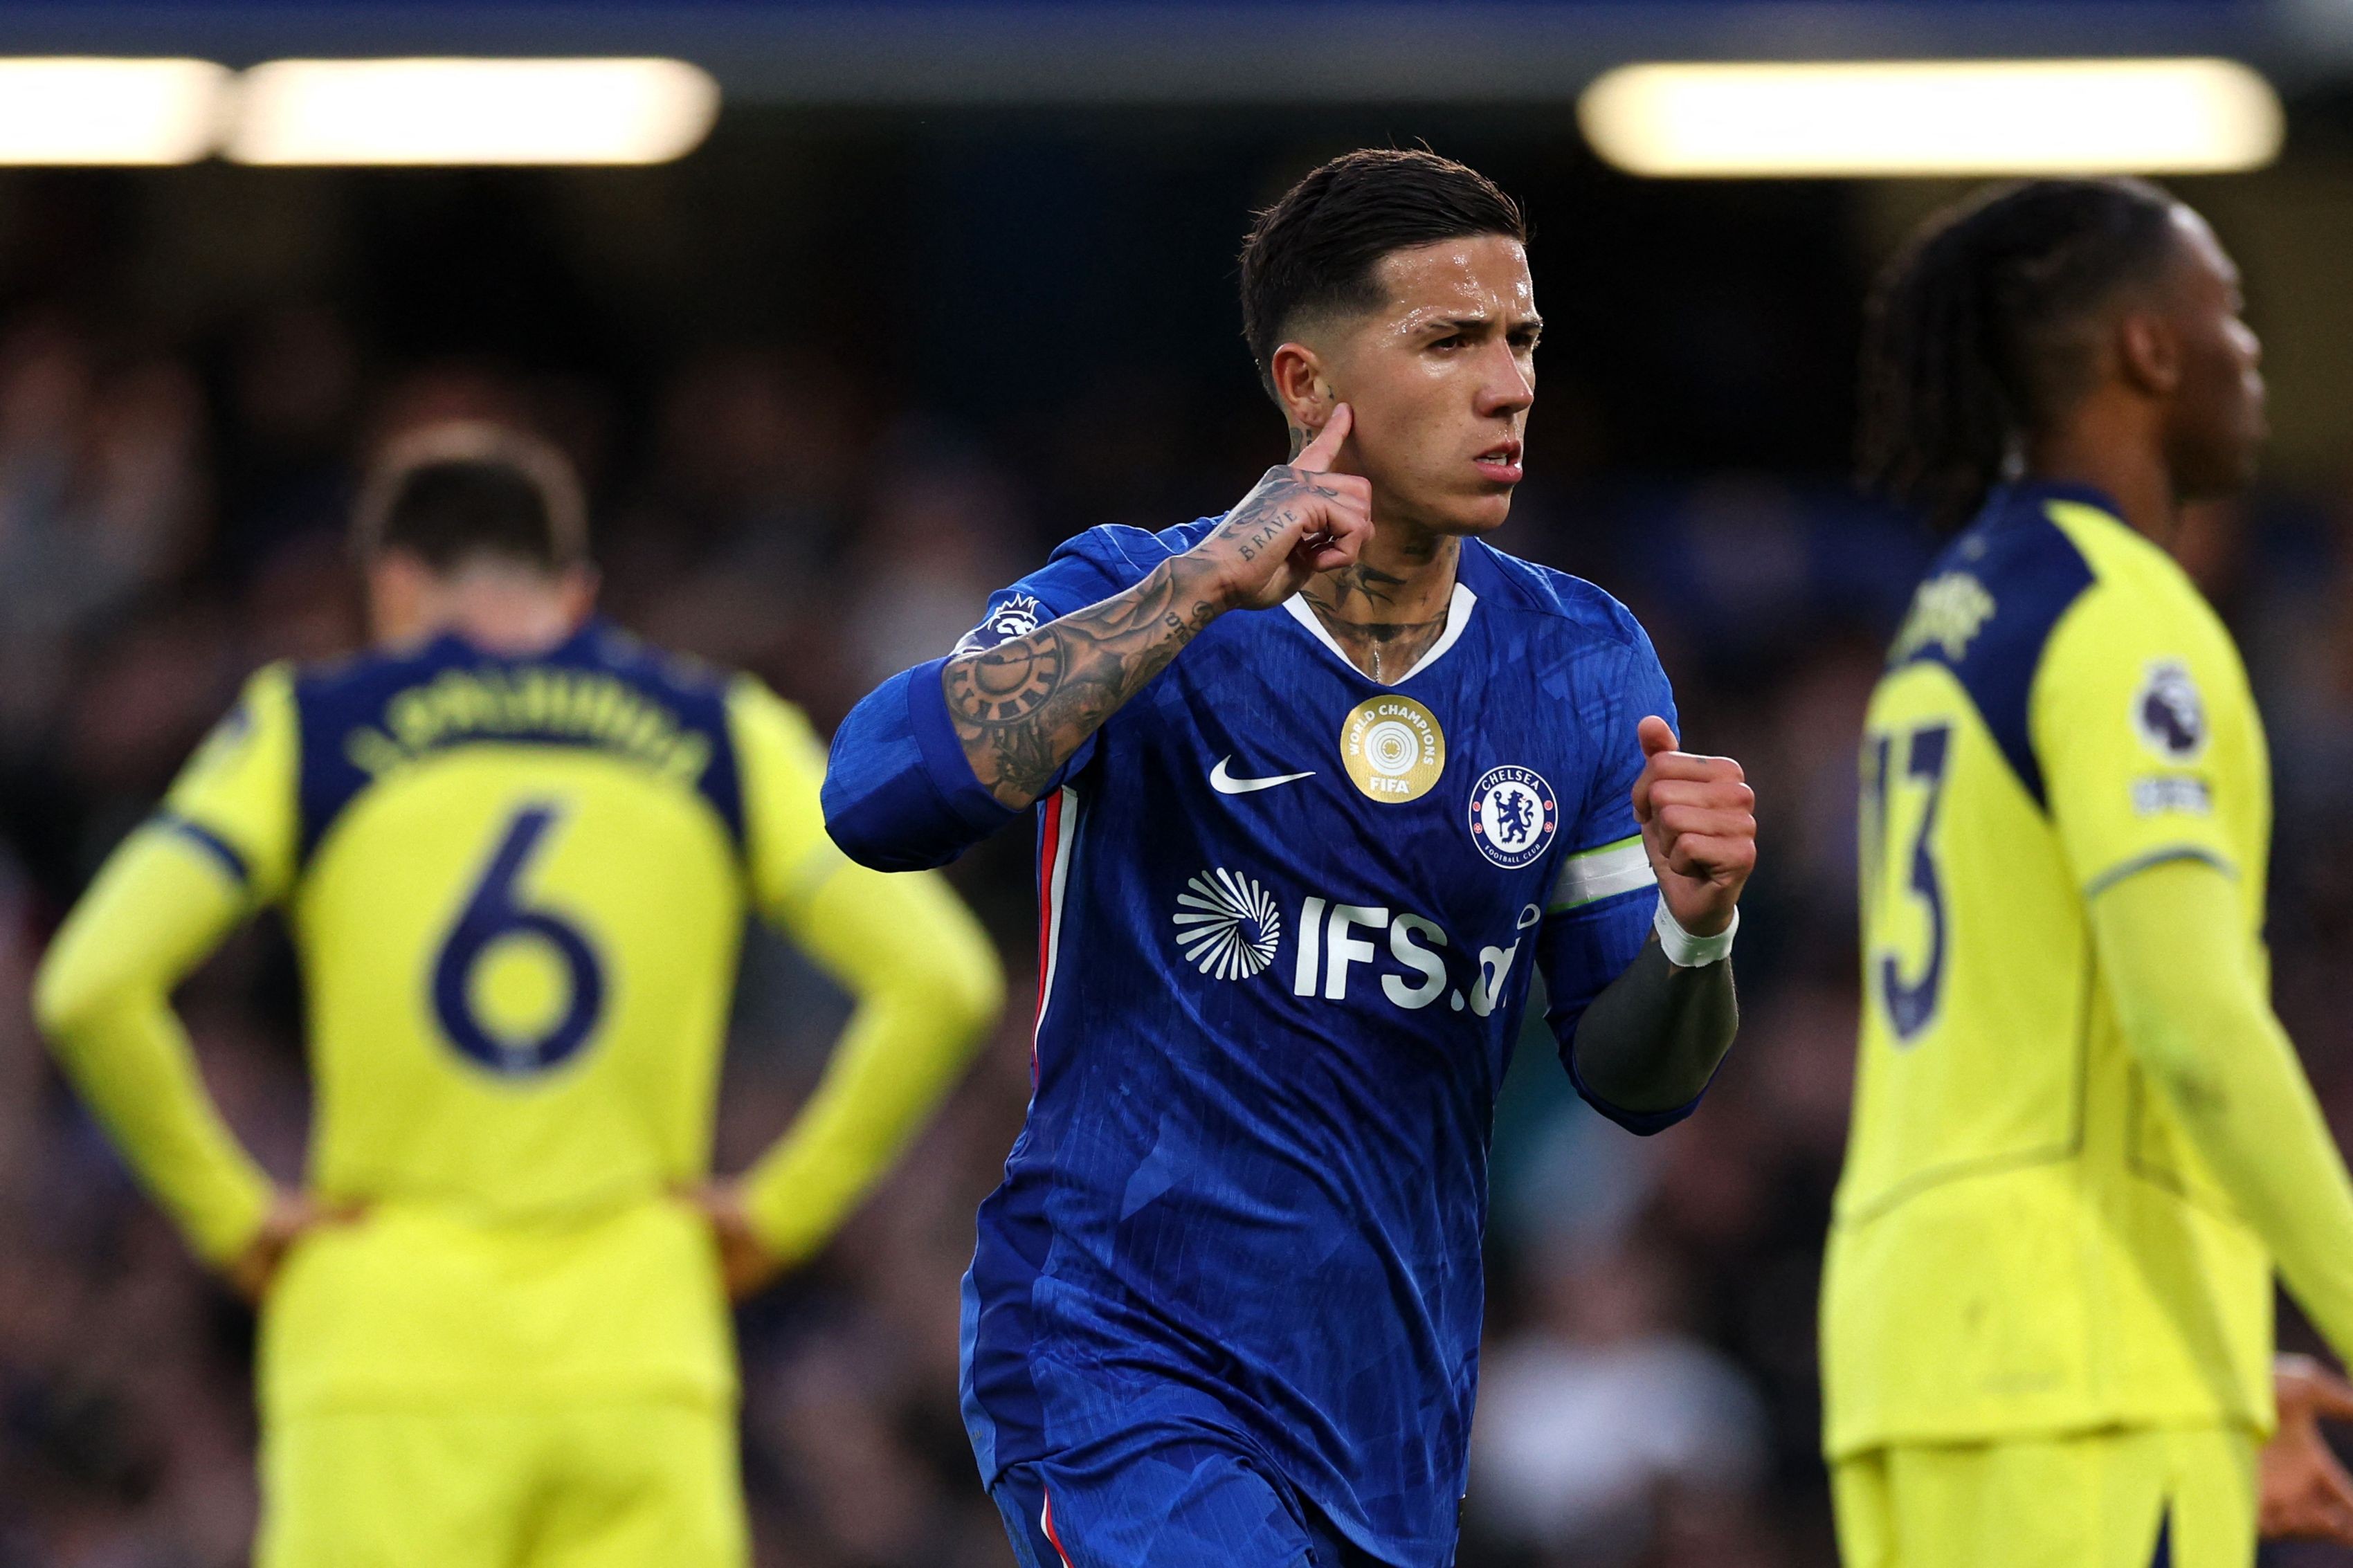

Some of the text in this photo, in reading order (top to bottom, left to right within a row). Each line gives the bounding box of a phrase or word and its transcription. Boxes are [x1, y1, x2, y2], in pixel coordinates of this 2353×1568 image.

[1238, 509, 1298, 562] BRAVE
[1349, 704, 1435, 766] WORLD CHAMPIONS
[1369, 776, 1410, 794] FIFA
[1481, 769, 1540, 792] CHELSEA
[1484, 843, 1541, 864] FOOTBALL CLUB
[430, 803, 604, 1074] 6
